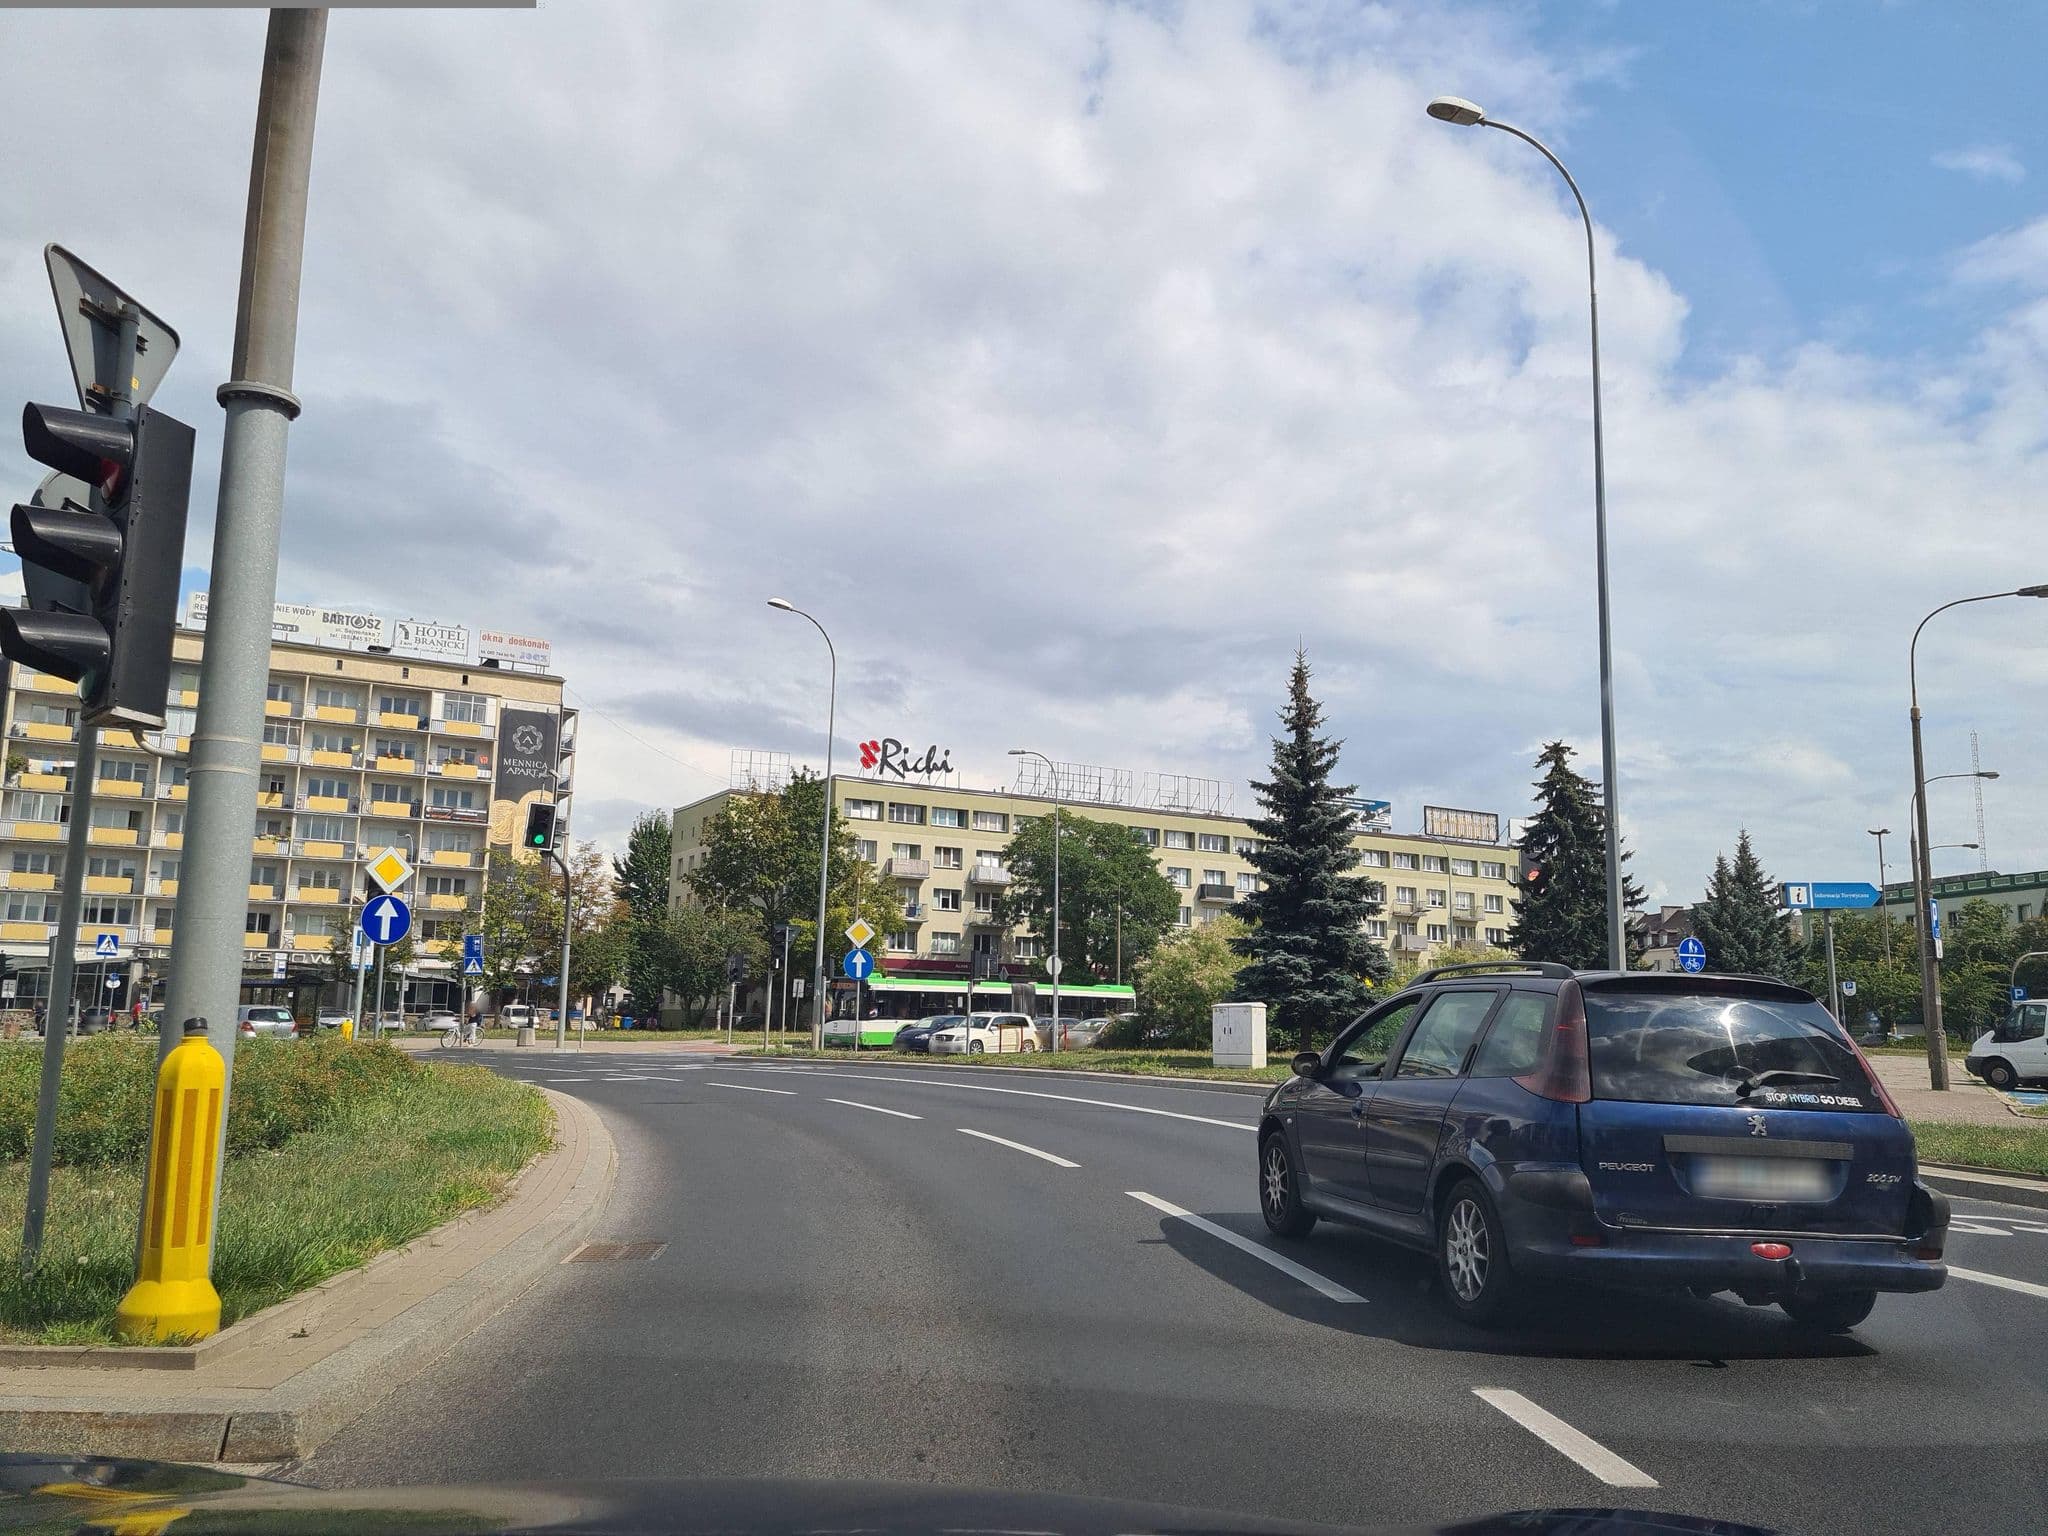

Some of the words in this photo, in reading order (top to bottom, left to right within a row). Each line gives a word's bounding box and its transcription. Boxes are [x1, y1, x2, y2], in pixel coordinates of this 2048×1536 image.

[276, 604, 290, 613] NIE
[292, 607, 316, 616] WODY
[322, 612, 381, 630] BARTOSZ
[415, 625, 465, 642] HOTEL
[481, 633, 503, 643] okna
[414, 637, 465, 650] BRANICKI
[504, 758, 548, 769] MENNICA
[879, 738, 953, 780] Richi
[2014, 988, 2024, 999] P
[1765, 1092, 1788, 1102] STOP
[1788, 1093, 1820, 1104] HYBRID
[1820, 1095, 1835, 1105] GO
[1835, 1096, 1863, 1107] DIESEL
[1599, 1162, 1656, 1172] PEUGEOT
